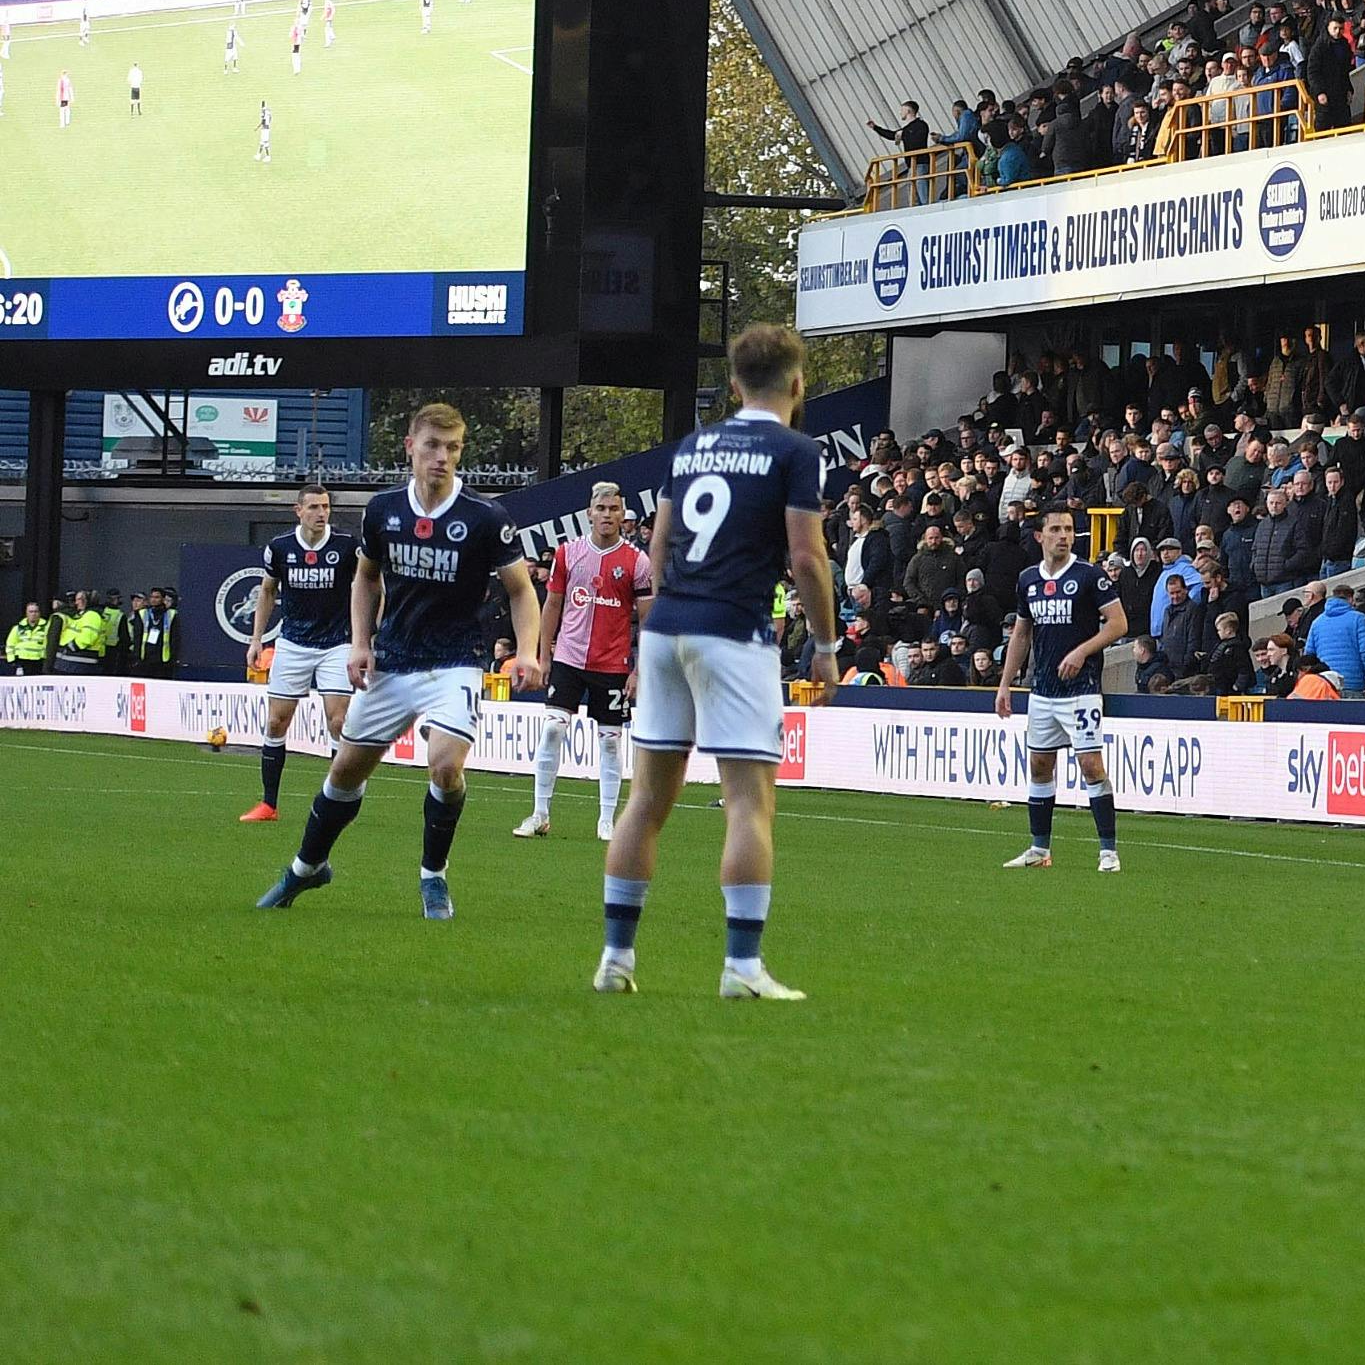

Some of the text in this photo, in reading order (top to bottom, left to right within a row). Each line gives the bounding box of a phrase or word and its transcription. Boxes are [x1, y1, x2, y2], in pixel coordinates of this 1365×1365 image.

[1320, 189, 1340, 221] CALL
[1342, 186, 1358, 218] 020
[920, 188, 1243, 290] SELHURST TIMBER & BUILDERS MERCHANTS
[214, 287, 265, 325] 0-0
[447, 285, 508, 312] HUSKI
[208, 352, 283, 376] adi.tv
[671, 450, 773, 478] BRADSHAW
[682, 474, 731, 563] 9
[288, 567, 335, 583] HUSKI
[388, 543, 459, 572] HUSKI
[391, 564, 457, 582] CHOCOLATE
[117, 685, 145, 728] sky bet
[179, 692, 204, 732] WITH
[1073, 708, 1101, 732] 39
[497, 714, 523, 761] THE
[873, 723, 919, 781] WITH
[924, 726, 958, 783] THE
[964, 727, 1008, 786] UK'S
[1160, 736, 1202, 798] APP
[1288, 745, 1324, 809] sky
